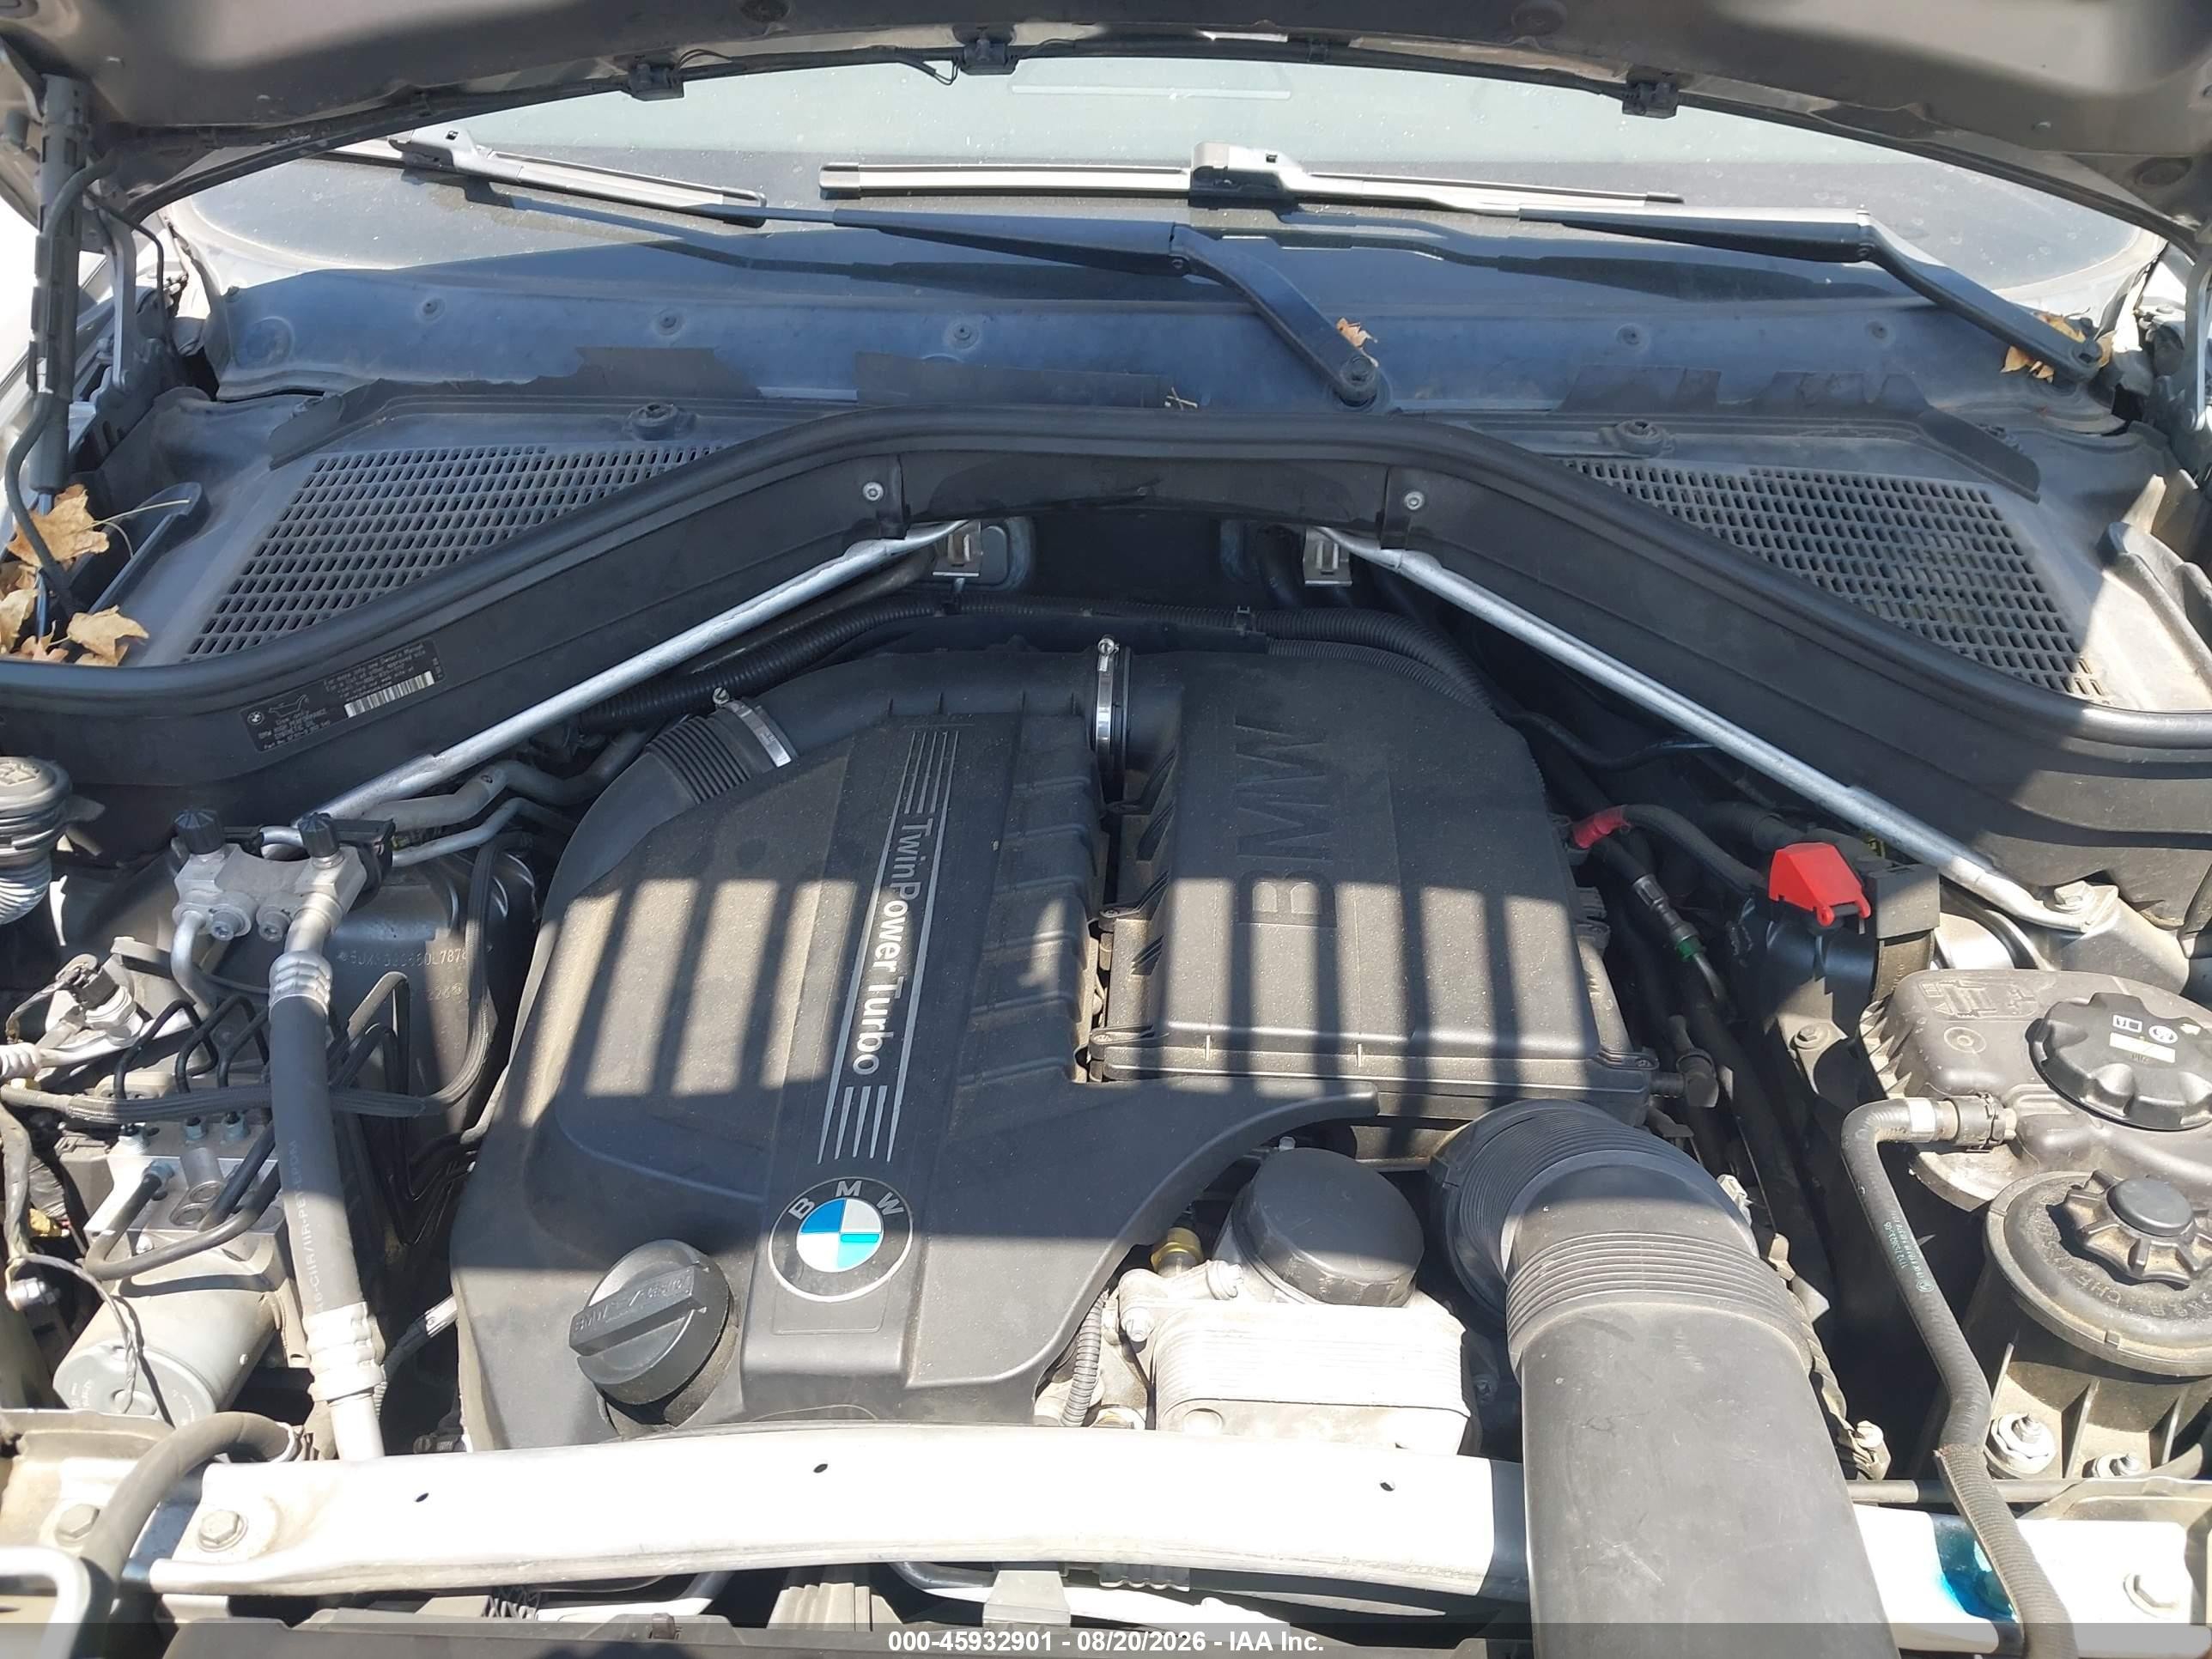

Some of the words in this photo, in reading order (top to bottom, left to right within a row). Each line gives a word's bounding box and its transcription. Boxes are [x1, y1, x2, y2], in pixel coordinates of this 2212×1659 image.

[872, 817, 933, 973] TwinPower
[1233, 713, 1338, 928] BMW
[852, 975, 904, 1075] Turbo
